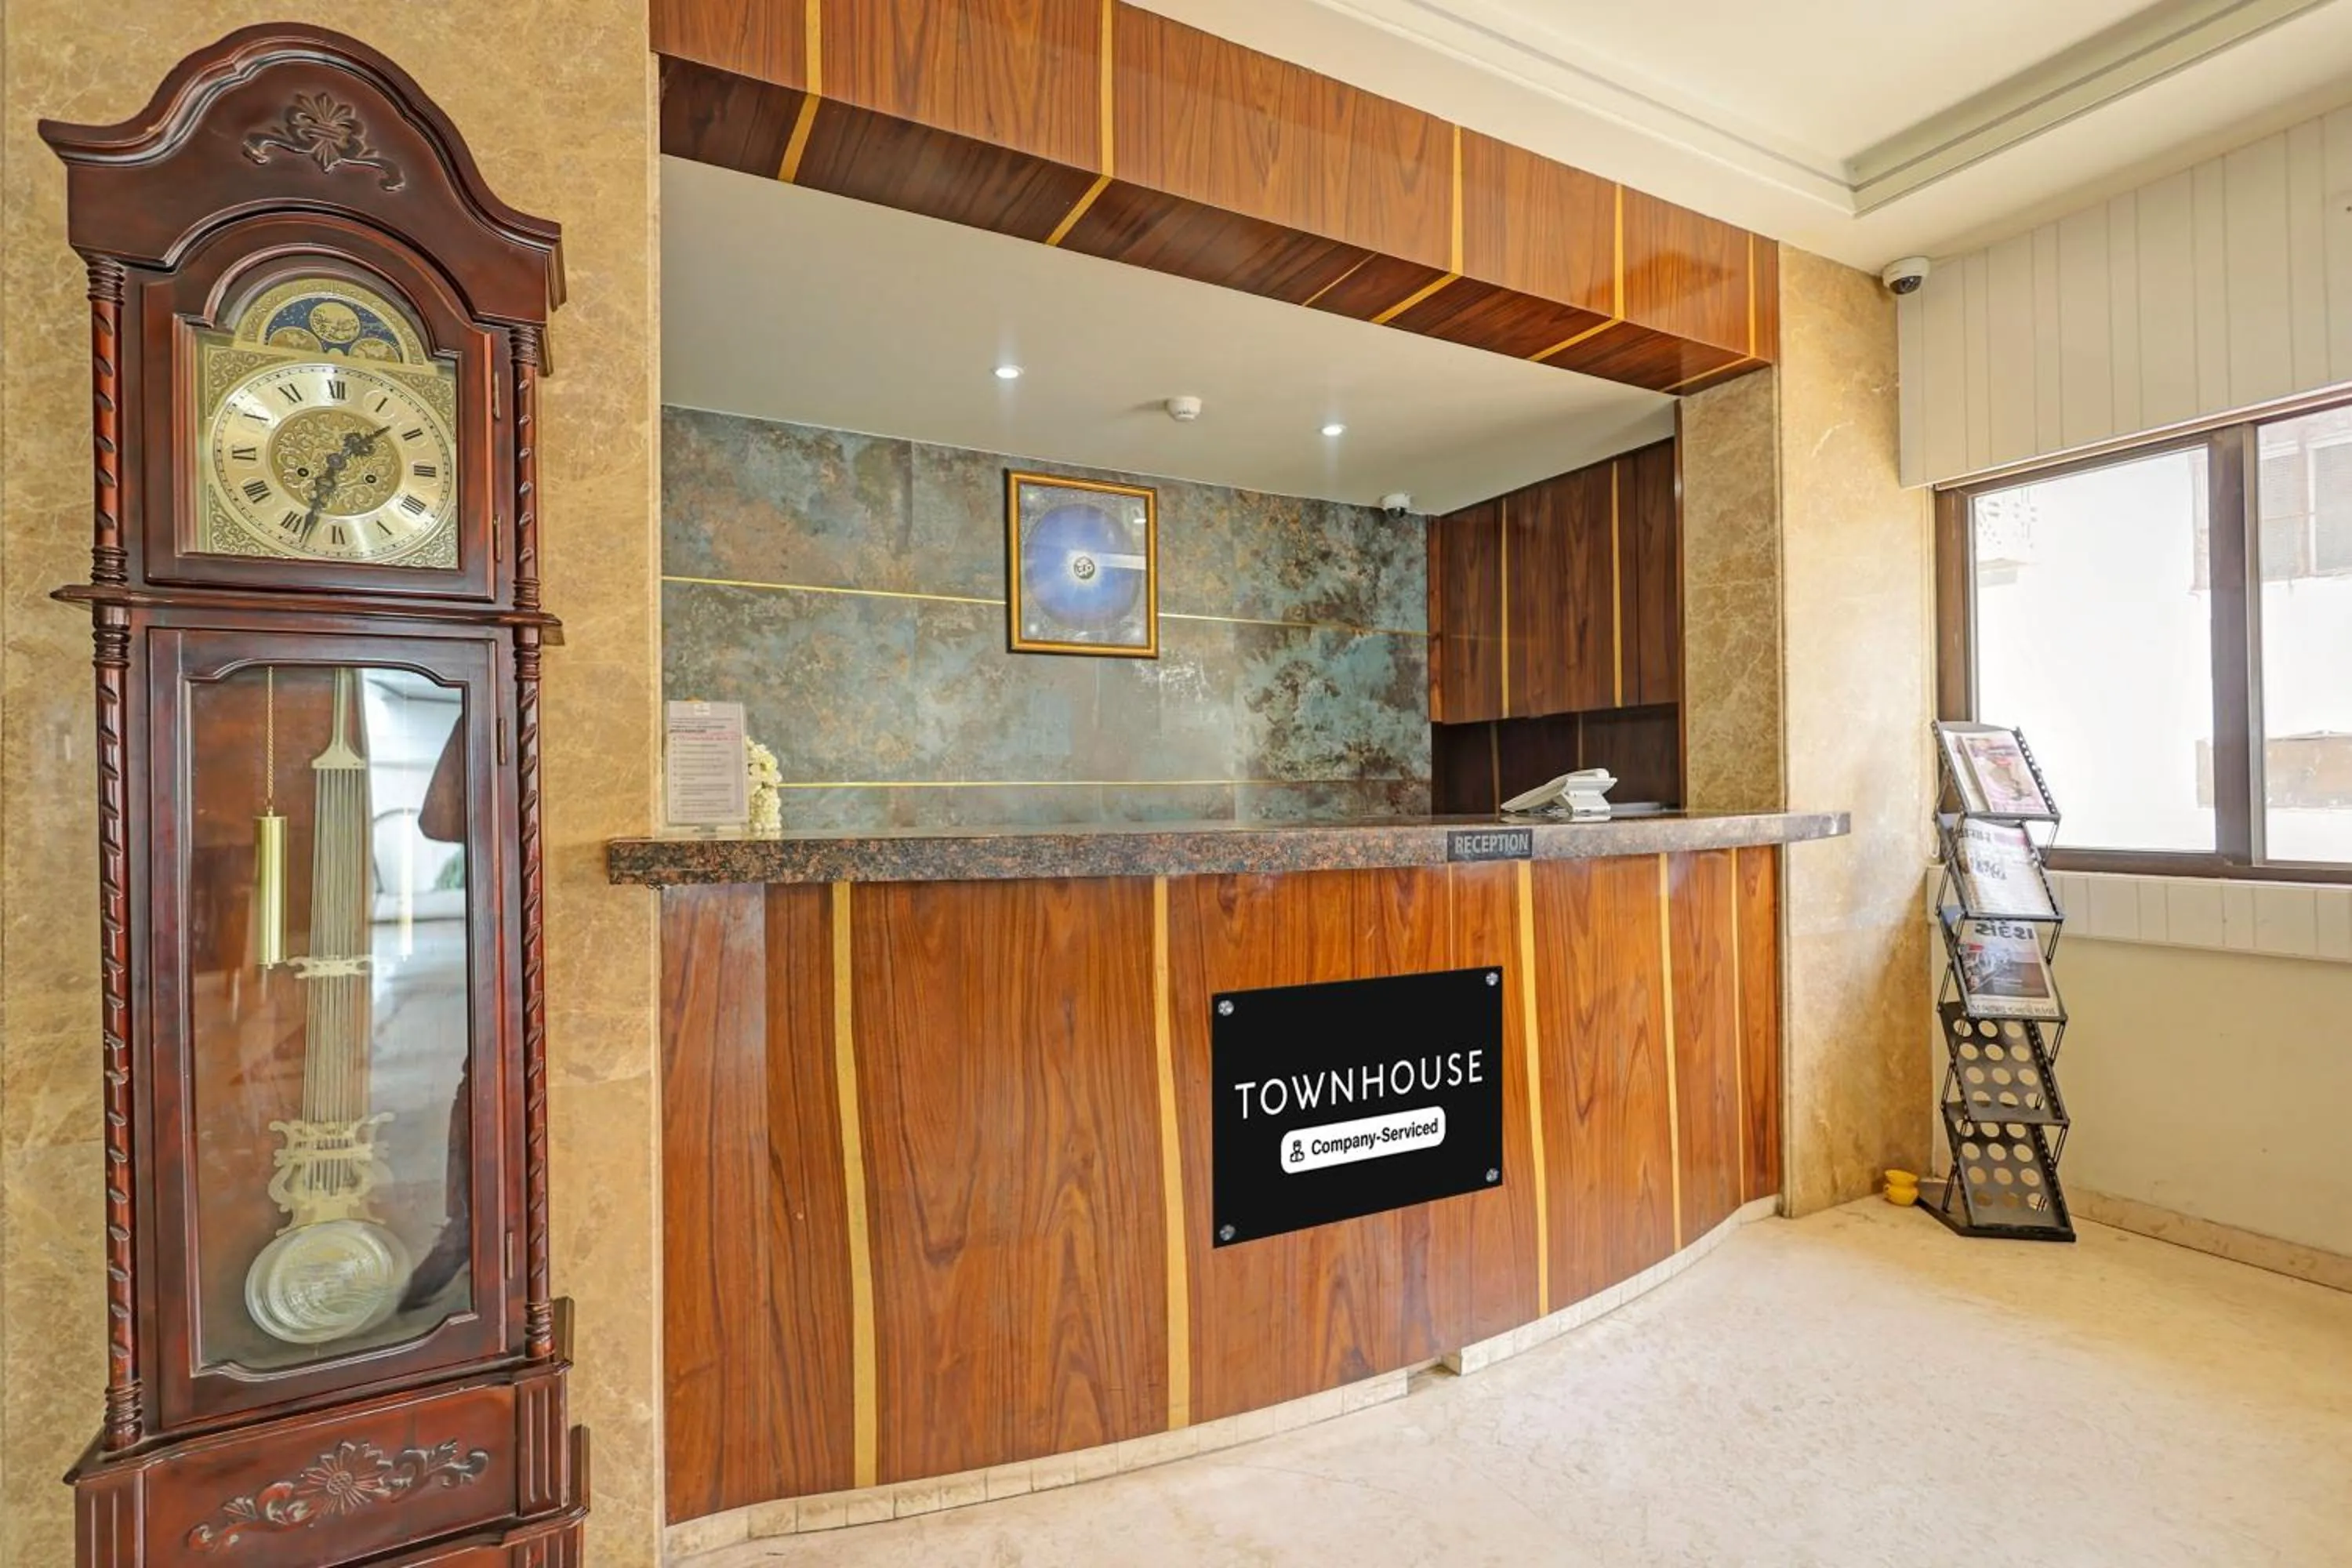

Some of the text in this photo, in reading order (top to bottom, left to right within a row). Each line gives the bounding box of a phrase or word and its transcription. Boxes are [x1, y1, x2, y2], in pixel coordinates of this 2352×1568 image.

[326, 379, 346, 400] XII
[401, 427, 423, 441] II
[413, 465, 437, 477] III
[401, 494, 426, 516] IIII
[1454, 833, 1529, 854] RECEPTION
[1235, 1050, 1483, 1120] TOWNHOUSE
[1311, 1118, 1439, 1156] Company-Serviced
